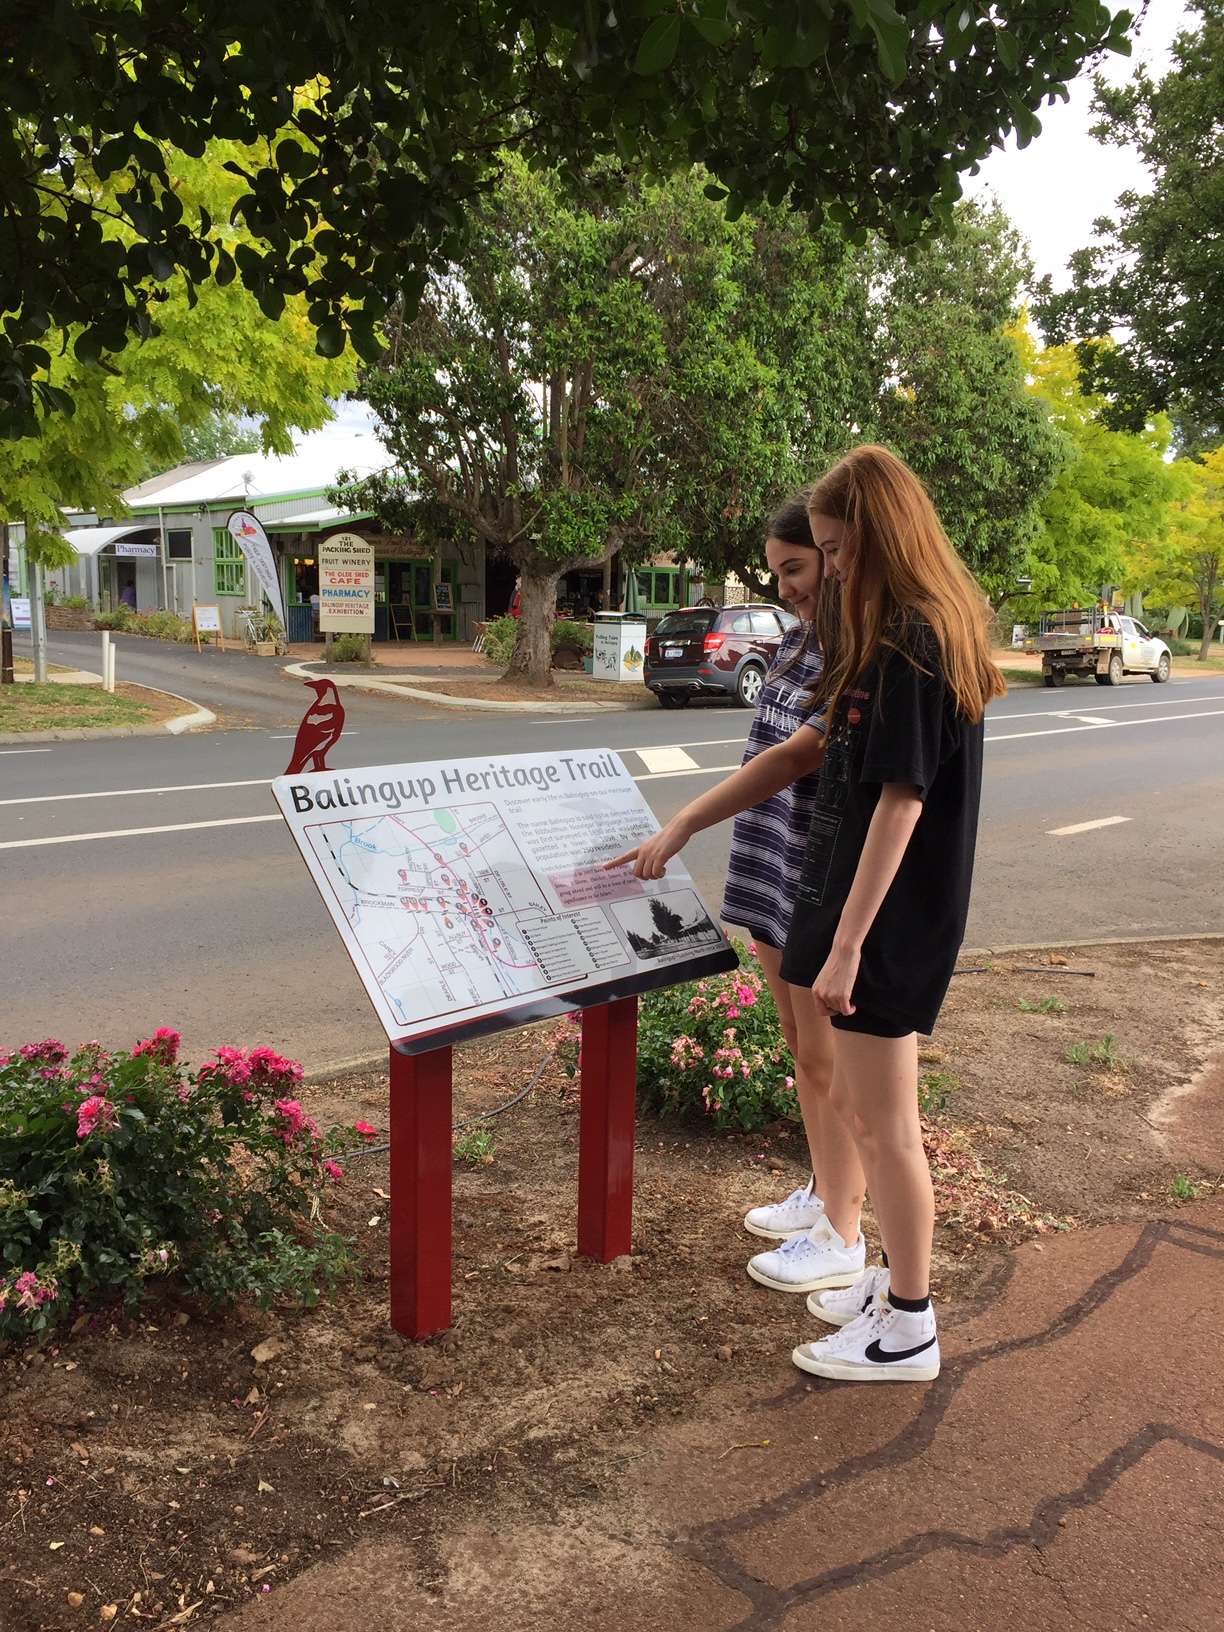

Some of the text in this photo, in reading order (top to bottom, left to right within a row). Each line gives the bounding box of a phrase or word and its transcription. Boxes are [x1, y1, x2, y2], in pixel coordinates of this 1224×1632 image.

[117, 544, 154, 555] Pharmacy
[322, 588, 370, 598] PHARMACY
[290, 753, 621, 813] Balingup Heritage Trail
